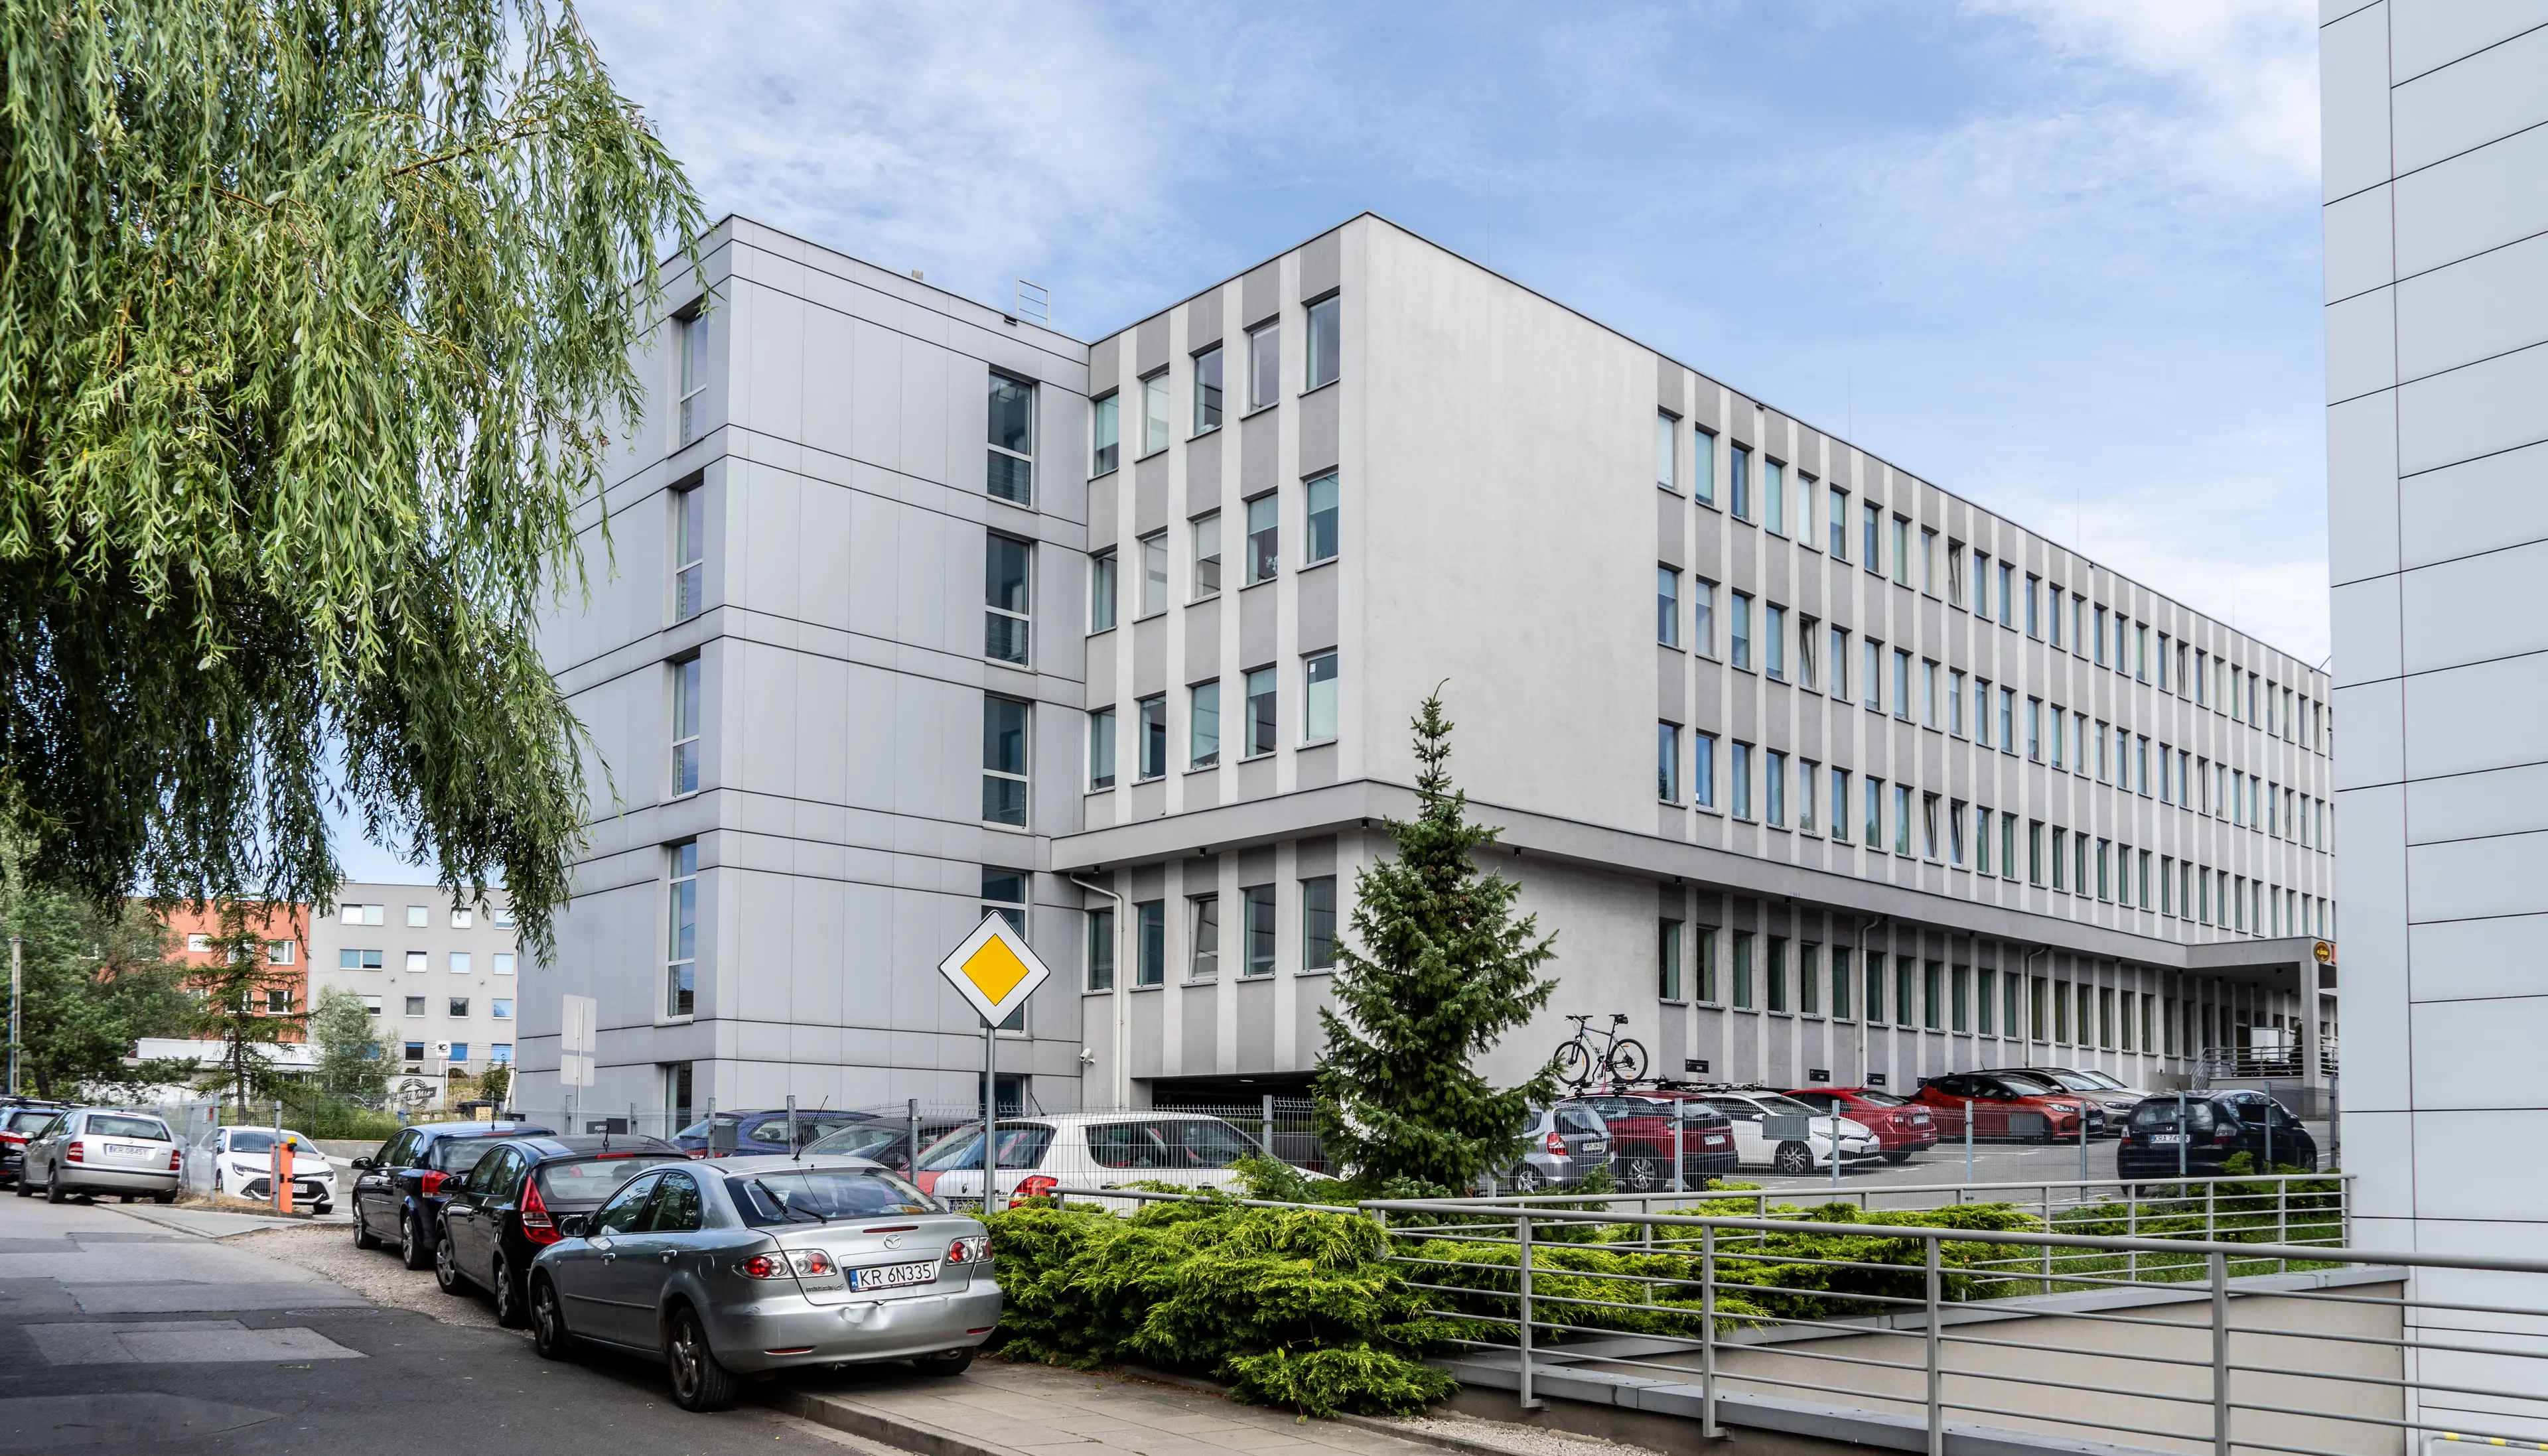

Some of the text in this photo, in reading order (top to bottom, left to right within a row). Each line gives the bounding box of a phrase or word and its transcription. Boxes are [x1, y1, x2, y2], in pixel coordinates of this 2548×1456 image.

[860, 1264, 932, 1286] KR 6N335
[834, 1282, 845, 1291] 6
